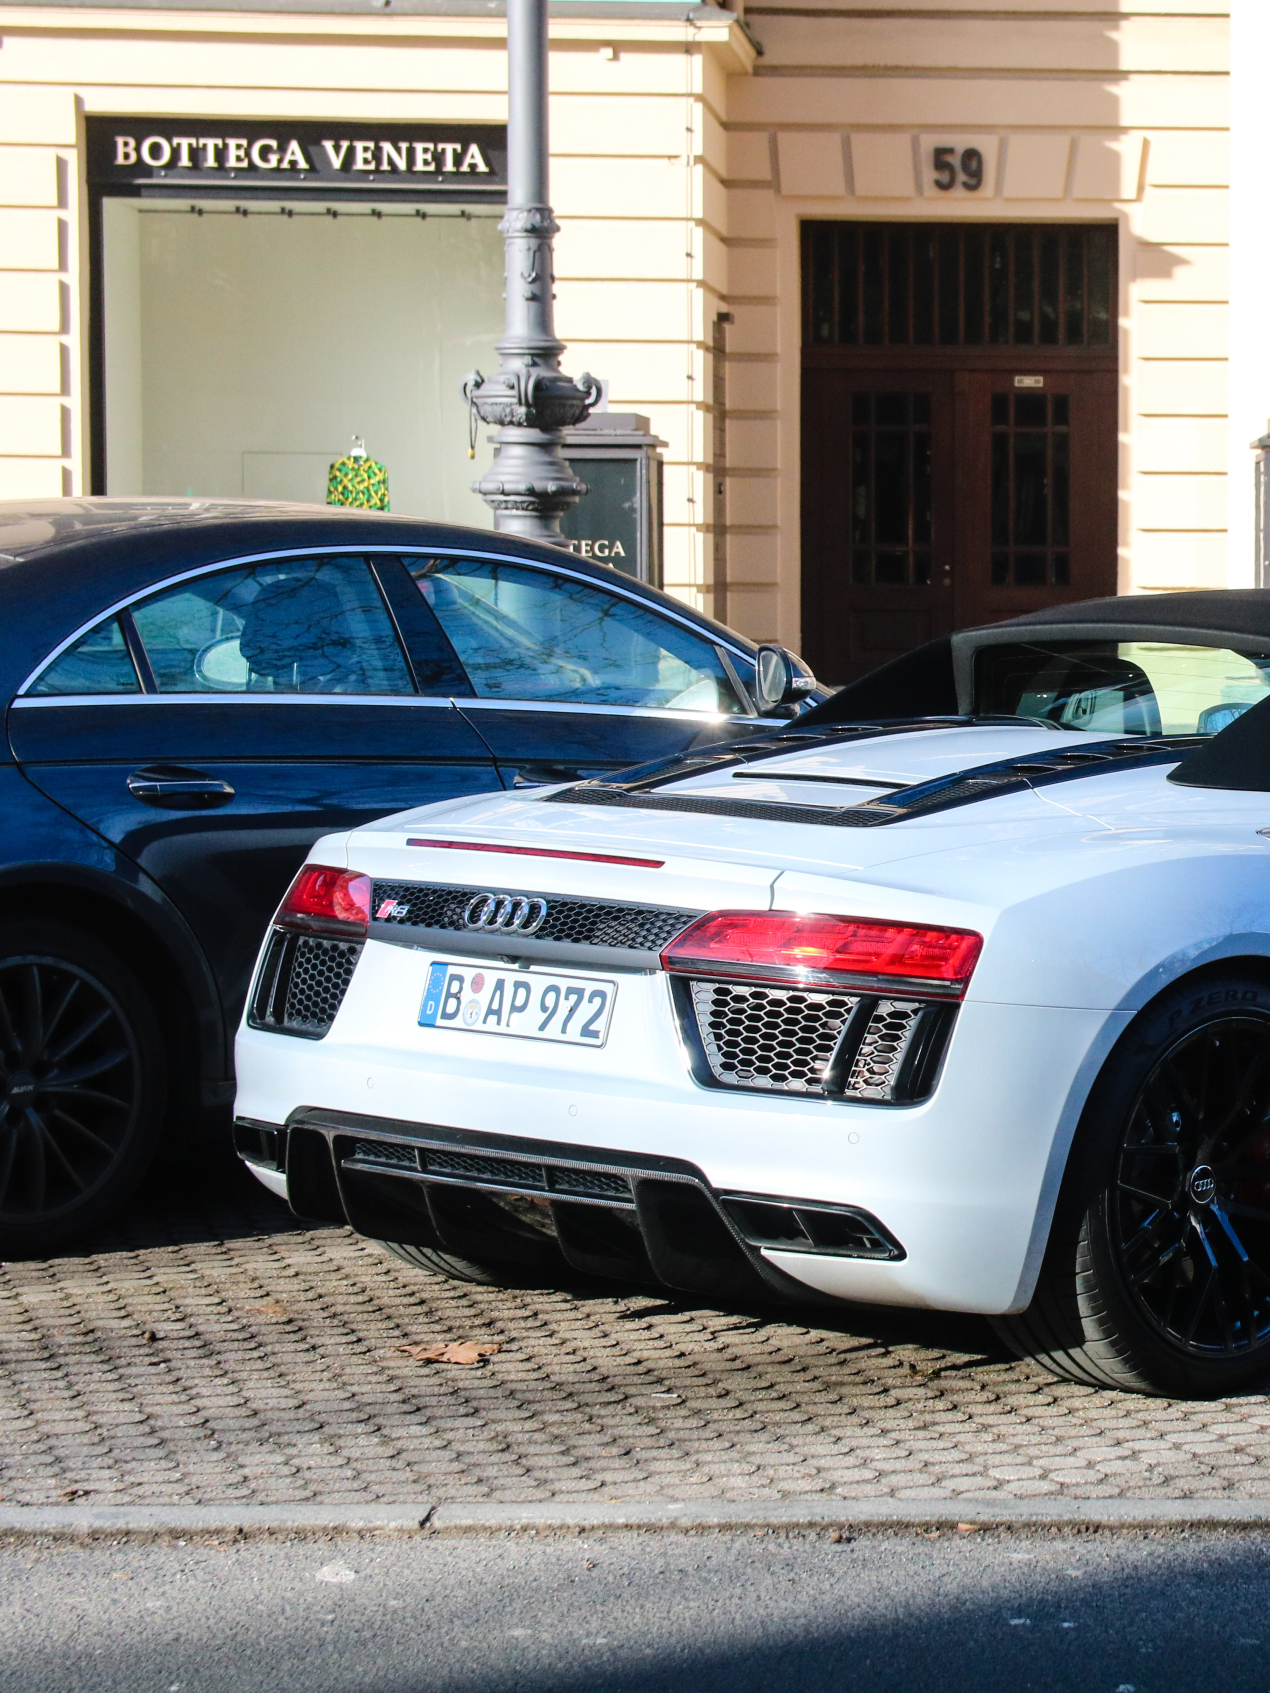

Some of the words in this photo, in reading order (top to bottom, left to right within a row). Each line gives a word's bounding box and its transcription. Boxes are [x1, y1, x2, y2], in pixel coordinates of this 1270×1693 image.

[114, 135, 310, 169] BOTTEGA
[321, 139, 490, 172] VENETA
[933, 147, 983, 191] 59
[426, 1001, 436, 1015] D
[440, 974, 465, 1020] B
[482, 978, 532, 1027] AP
[538, 984, 608, 1039] 972
[1190, 989, 1259, 1015] ZERO
